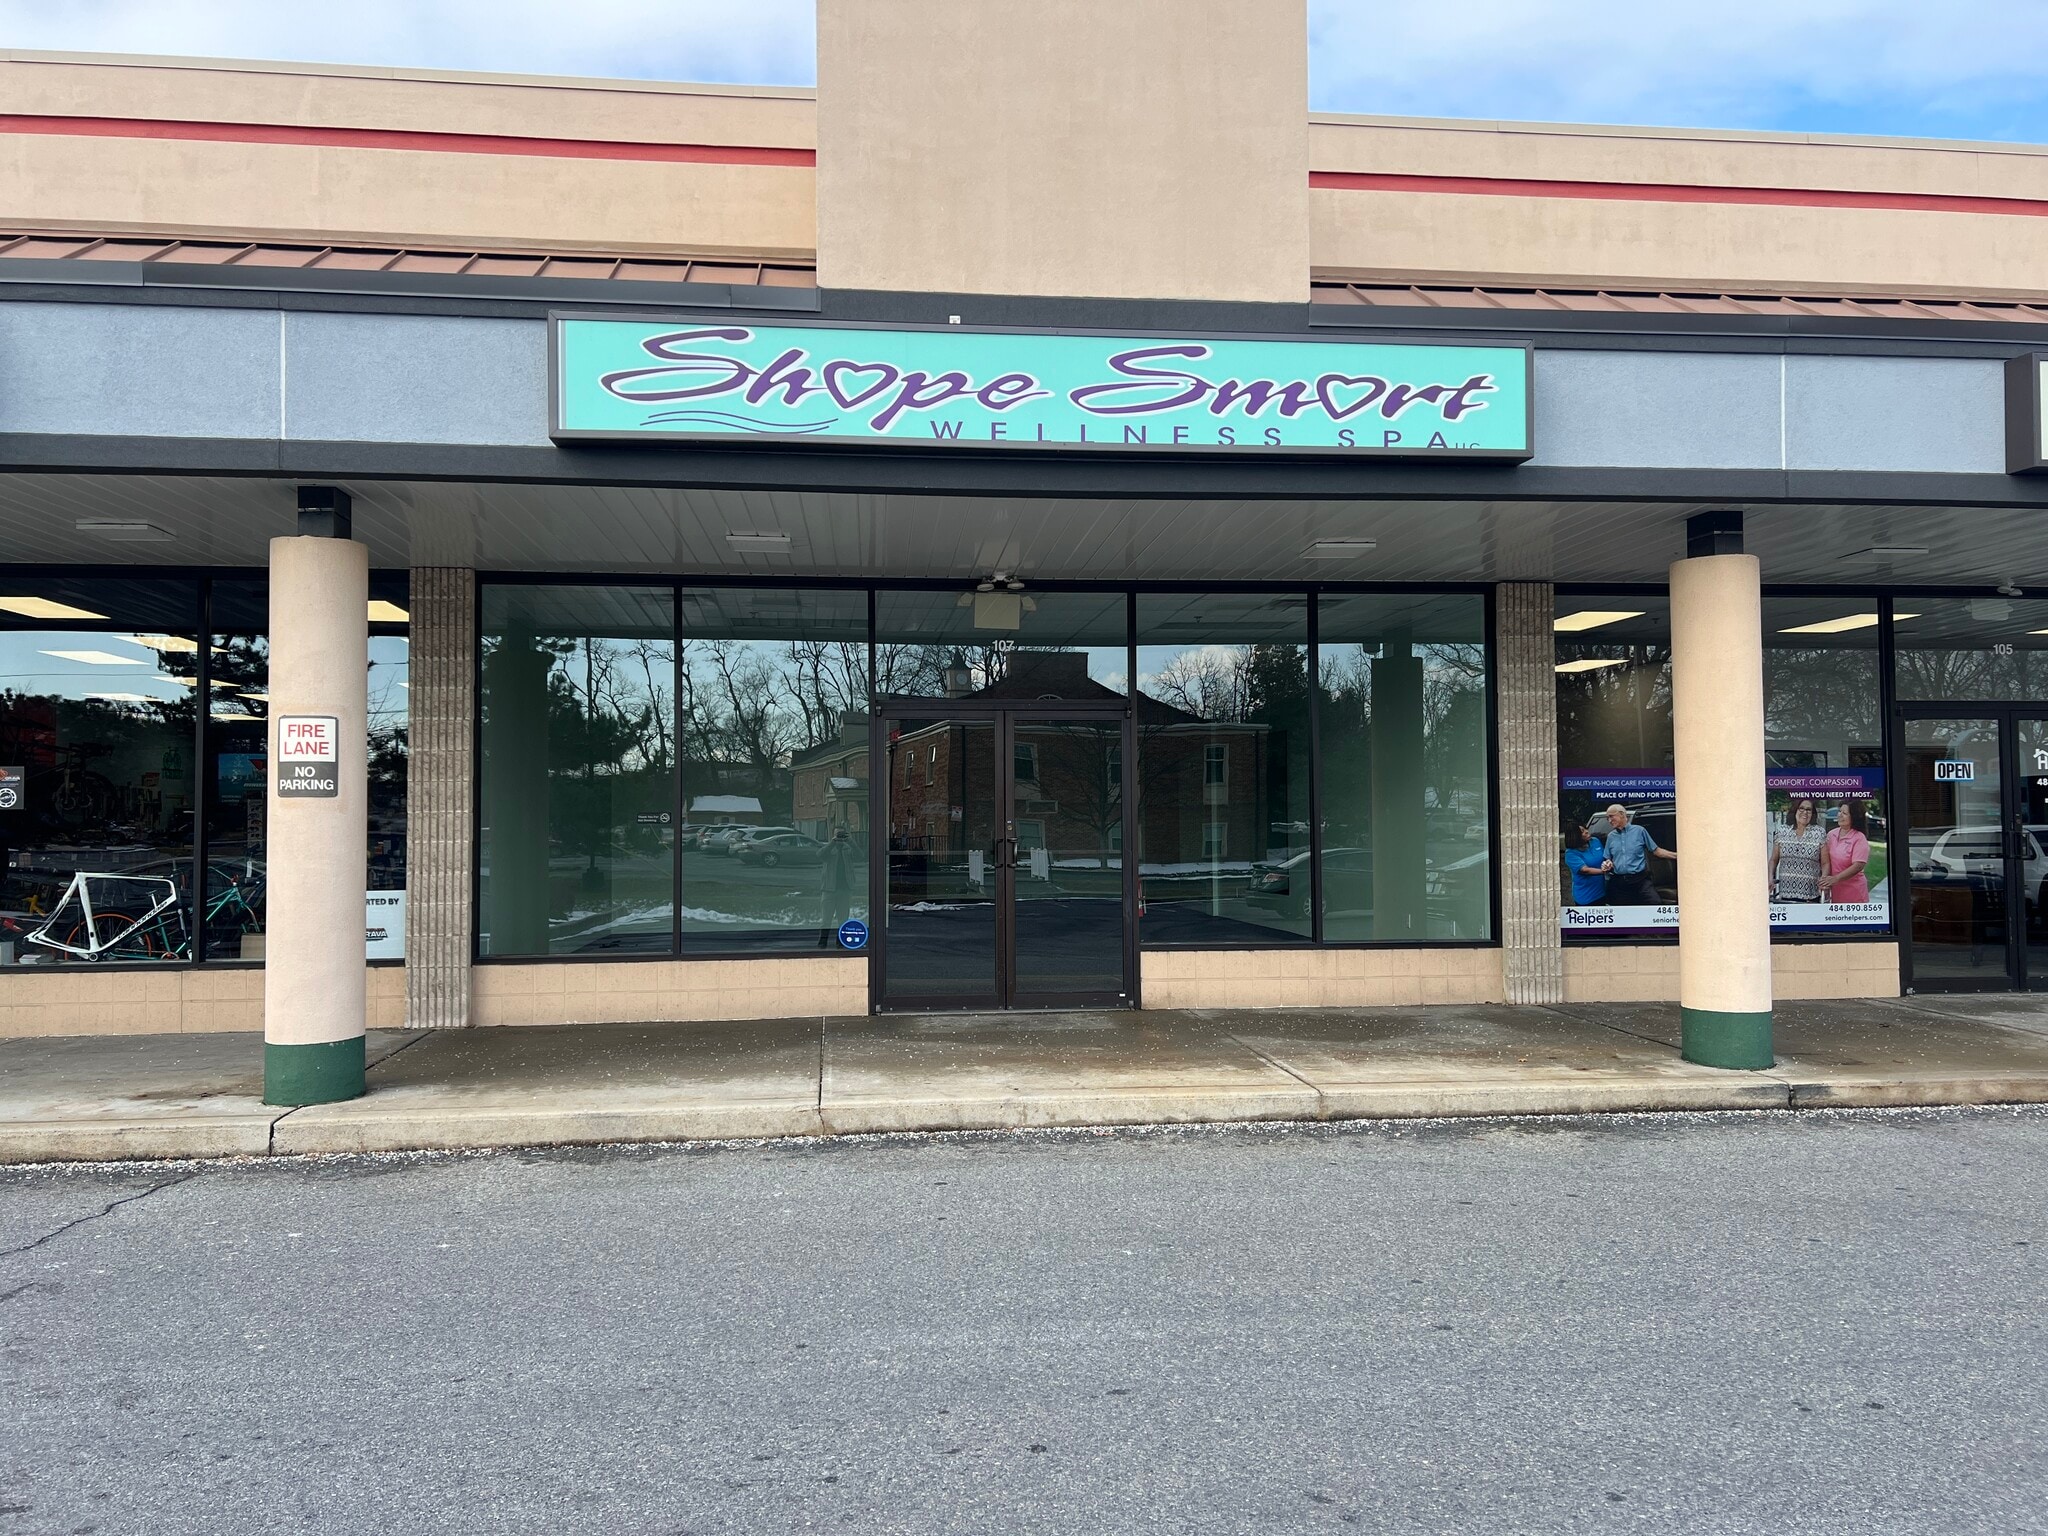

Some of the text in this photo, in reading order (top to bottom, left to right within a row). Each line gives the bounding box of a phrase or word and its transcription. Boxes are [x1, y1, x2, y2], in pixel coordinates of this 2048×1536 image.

[930, 421, 1281, 447] WELLNESS
[1338, 429, 1448, 449] SPA
[992, 640, 1014, 651] 107
[1993, 644, 2013, 655] 105
[288, 724, 325, 737] FIRE
[284, 742, 329, 754] LANE
[295, 766, 315, 777] NO
[1938, 763, 1971, 778] OPEN
[280, 779, 334, 790] PARKING
[1768, 779, 1808, 787] COMFORT,
[1829, 904, 1883, 912] 484.890.8569
[1569, 912, 1614, 926] Helpers
